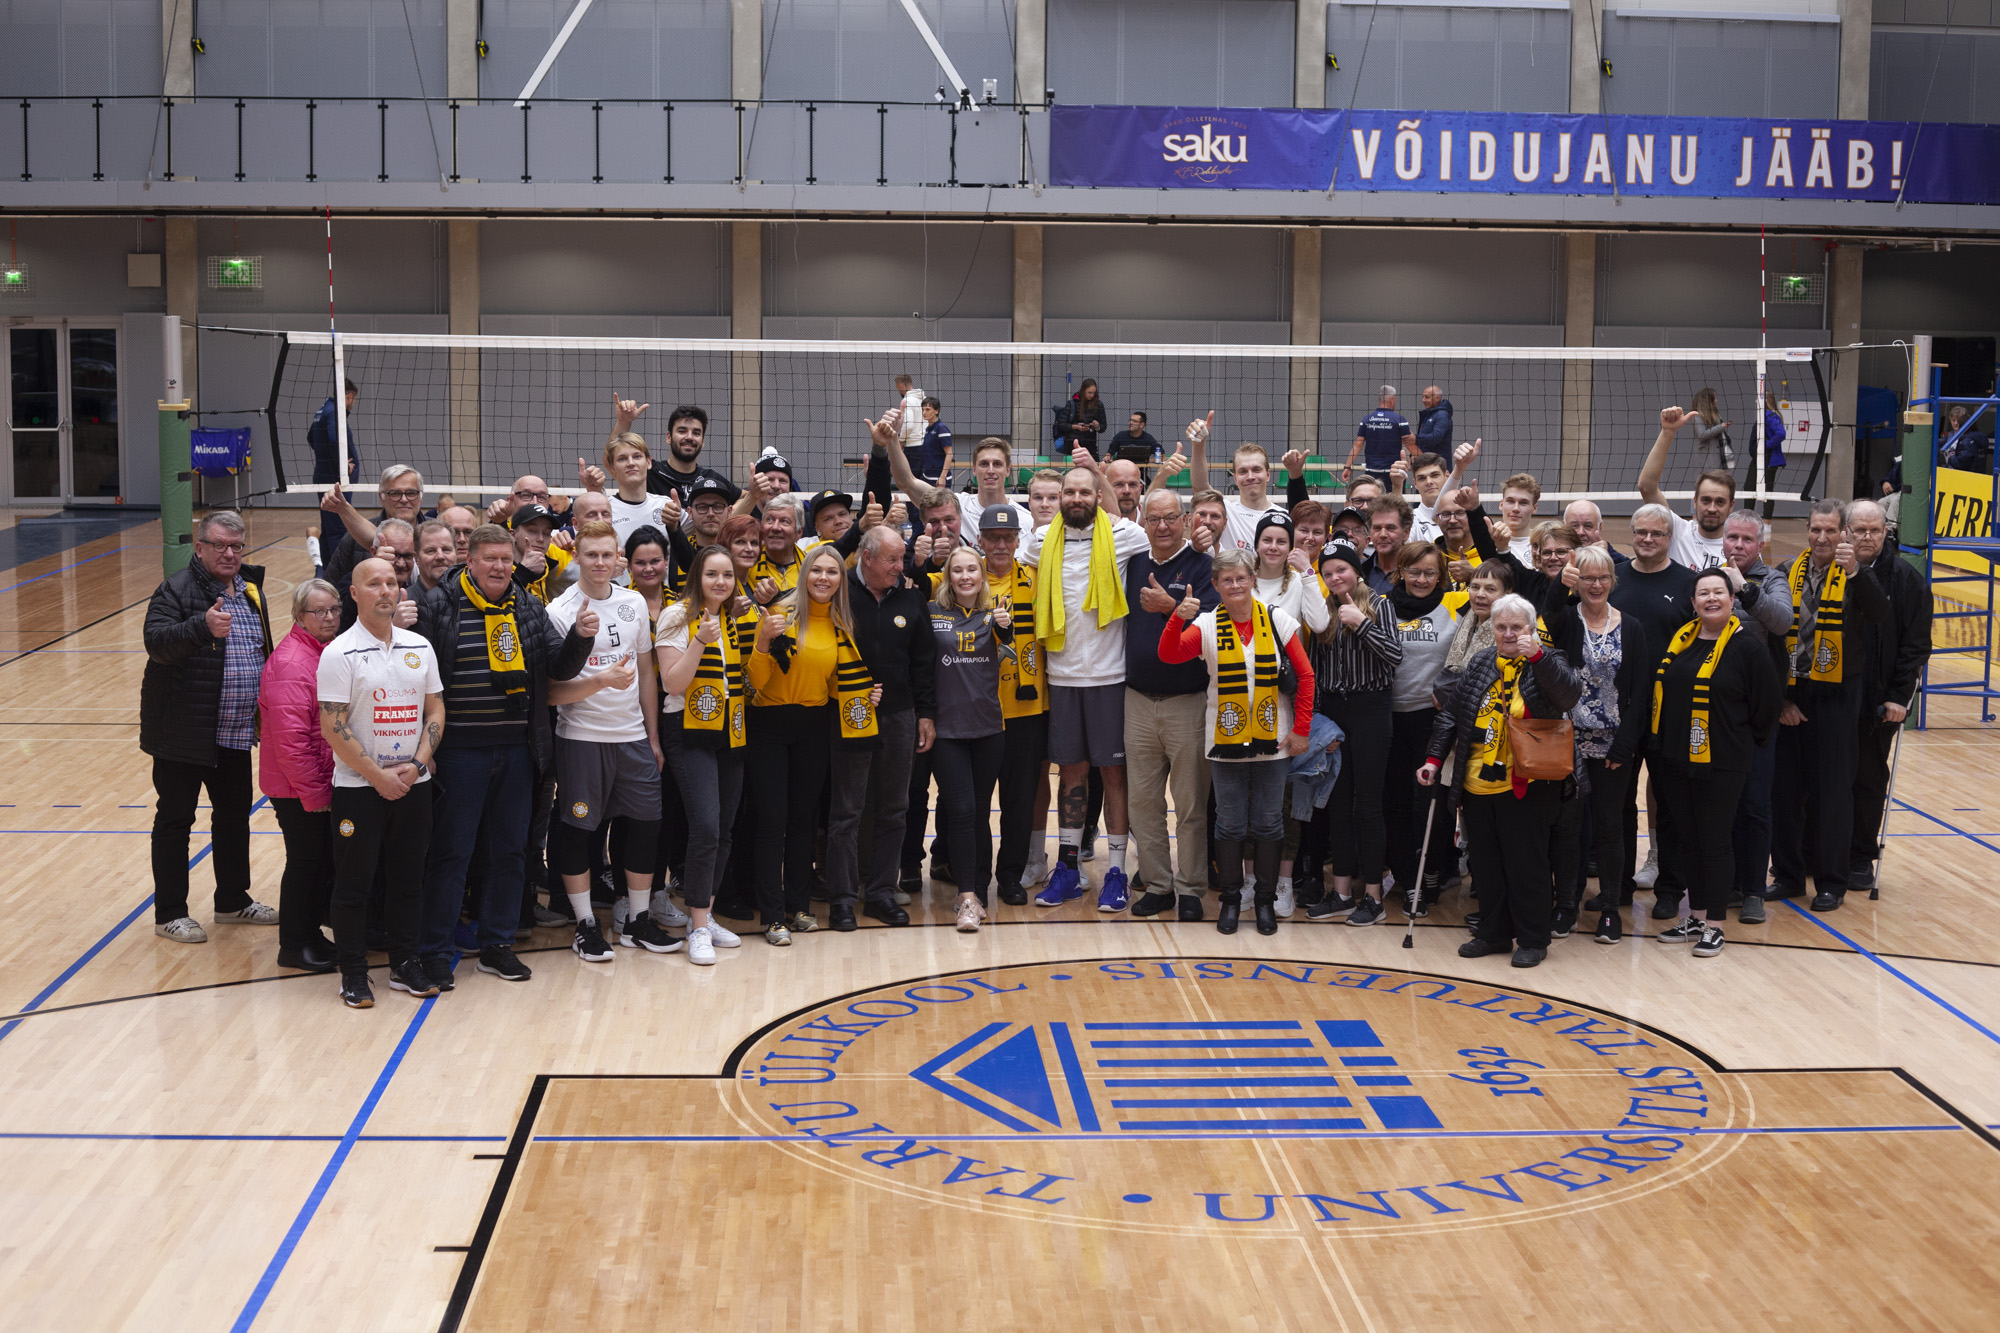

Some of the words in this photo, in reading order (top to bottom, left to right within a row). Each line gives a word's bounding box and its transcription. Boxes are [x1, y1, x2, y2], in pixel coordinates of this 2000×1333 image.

[1162, 123, 1249, 163] saku
[1352, 119, 1698, 186] VÕIDUJANU
[1735, 127, 1903, 190] JÄÄB!
[605, 623, 620, 647] 5
[956, 631, 976, 652] 12
[600, 654, 618, 665] ETS
[387, 687, 417, 699] OSUMA
[373, 729, 402, 737] VIKING
[403, 728, 417, 736] LINE
[374, 709, 418, 719] FRANKE
[1099, 962, 1657, 1056] TARTUENSIS
[741, 976, 1028, 1087] ÜLIKOOL
[1447, 1046, 1546, 1098] 1632
[769, 1100, 1076, 1205] TARTU
[1195, 1066, 1709, 1222] UNIVERSITAS
